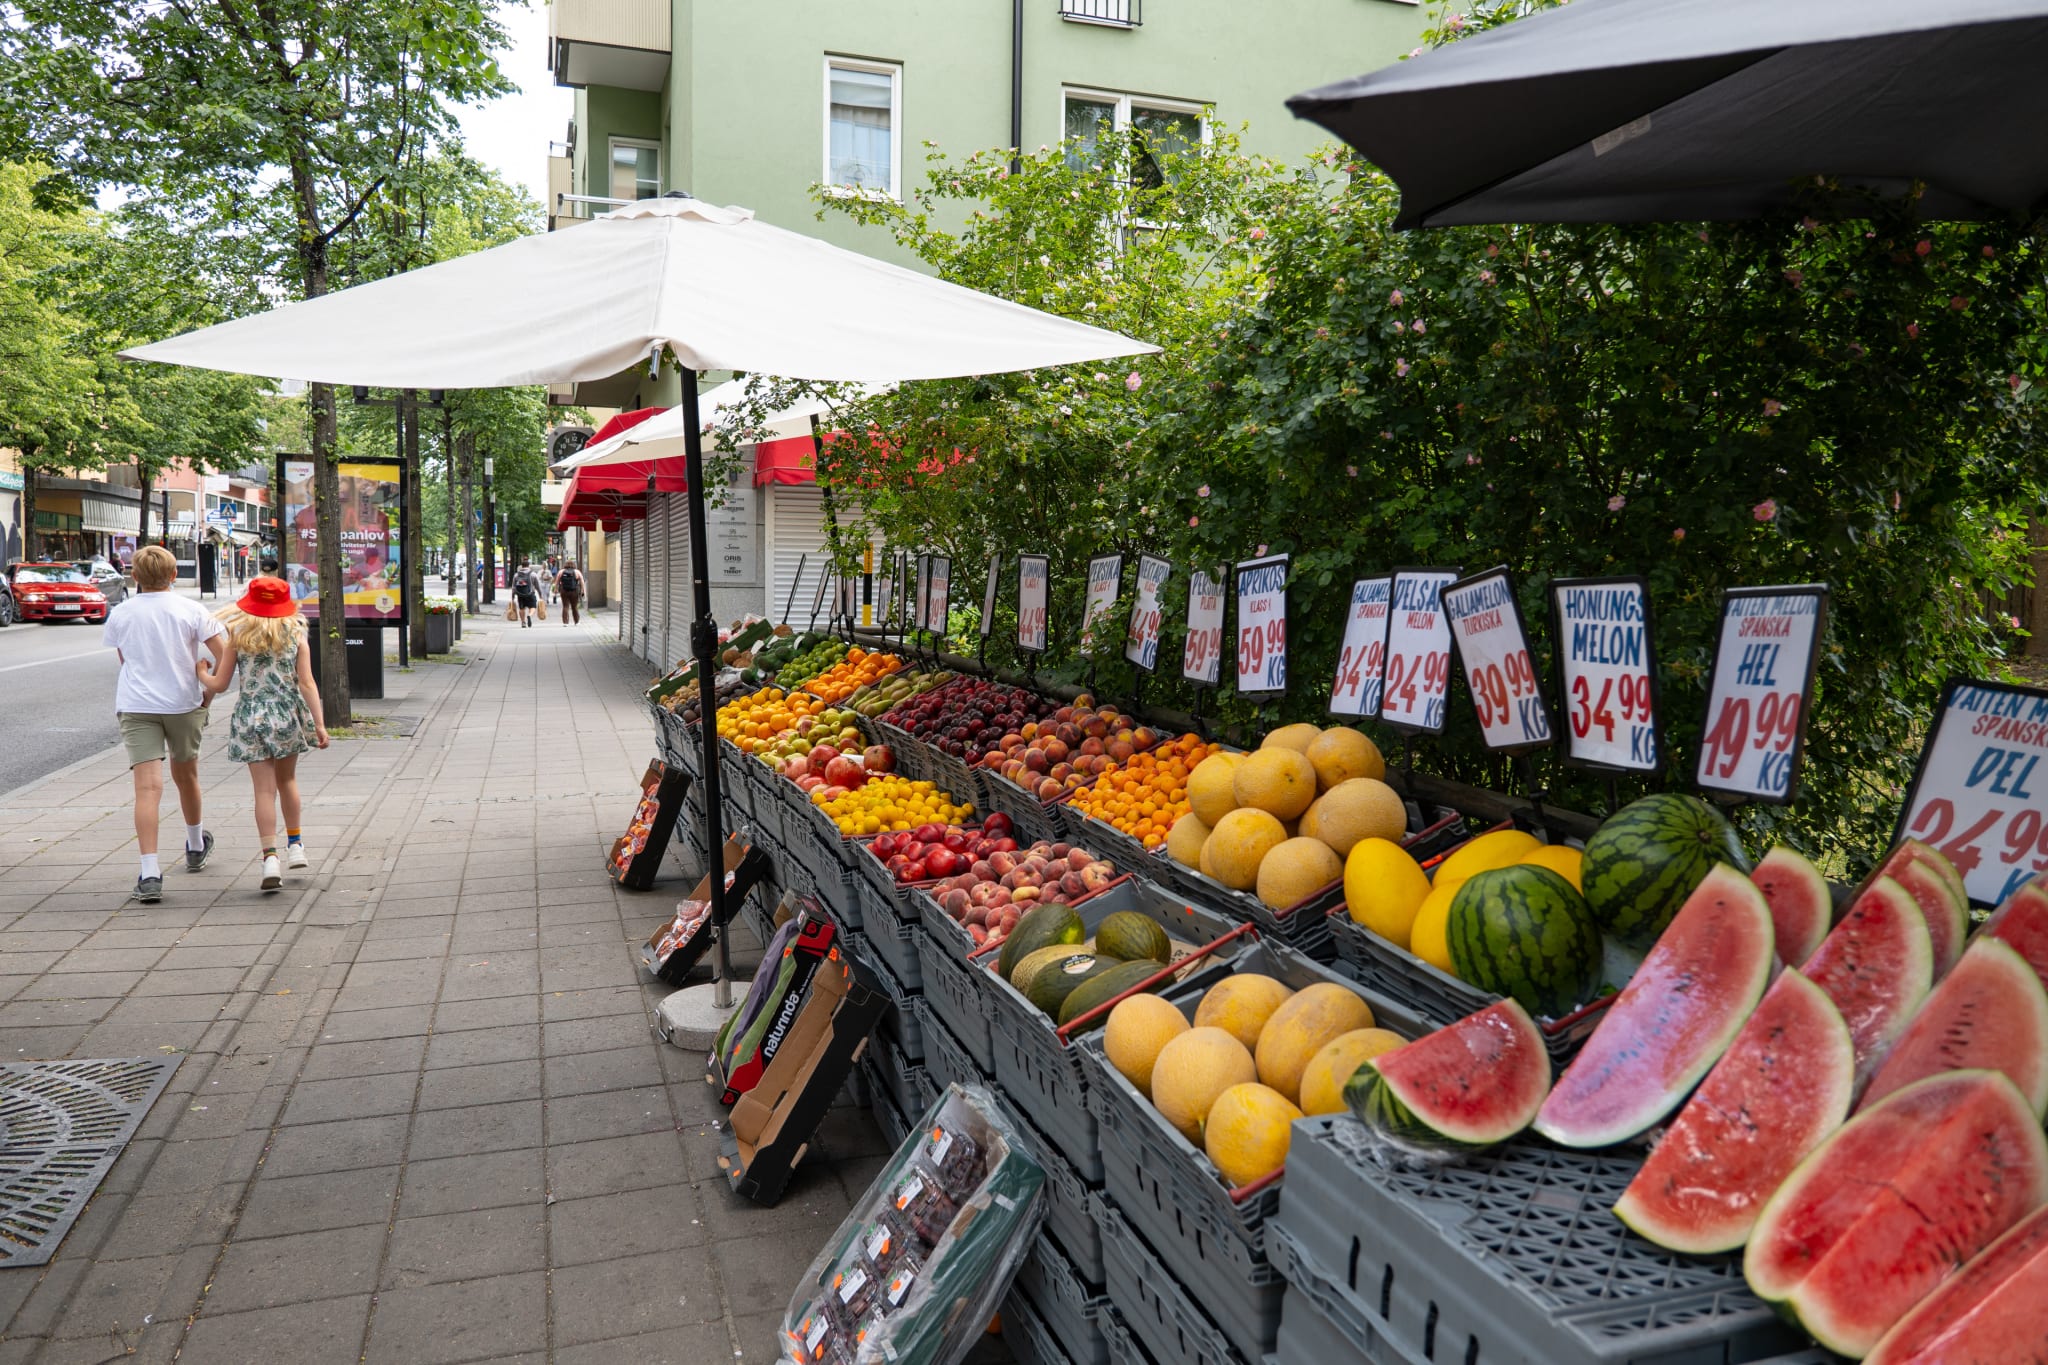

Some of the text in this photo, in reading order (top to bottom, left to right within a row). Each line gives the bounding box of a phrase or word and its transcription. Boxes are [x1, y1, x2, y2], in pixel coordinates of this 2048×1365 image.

[1089, 559, 1121, 583] PERSIKA
[1239, 564, 1285, 597] APRIKOS
[1250, 601, 1267, 614] KLASS
[1352, 582, 1391, 605] GALIAMEL
[1393, 578, 1449, 612] DELSA
[1448, 580, 1513, 621] GALIAMELON
[1566, 589, 1644, 623] HONUNGS
[1357, 604, 1388, 619] SPANSKA
[1406, 612, 1436, 630] MELON
[1463, 609, 1504, 637] TURKISKA
[1738, 615, 1792, 637] SPANSKA
[1142, 639, 1157, 668] KG
[1572, 623, 1645, 667] MELON
[1208, 659, 1220, 682] KG
[1267, 655, 1286, 688] KG
[1736, 643, 1781, 687] HEL
[1359, 678, 1383, 715] KG
[1424, 697, 1445, 729] KG
[2017, 697, 2048, 724] M
[1518, 697, 1548, 741] KG
[1971, 714, 2048, 748] SPANSK
[1631, 724, 1656, 764] KG
[1756, 751, 1791, 792] KG
[1964, 746, 2041, 801] DEL
[763, 992, 801, 1058] naturinda
